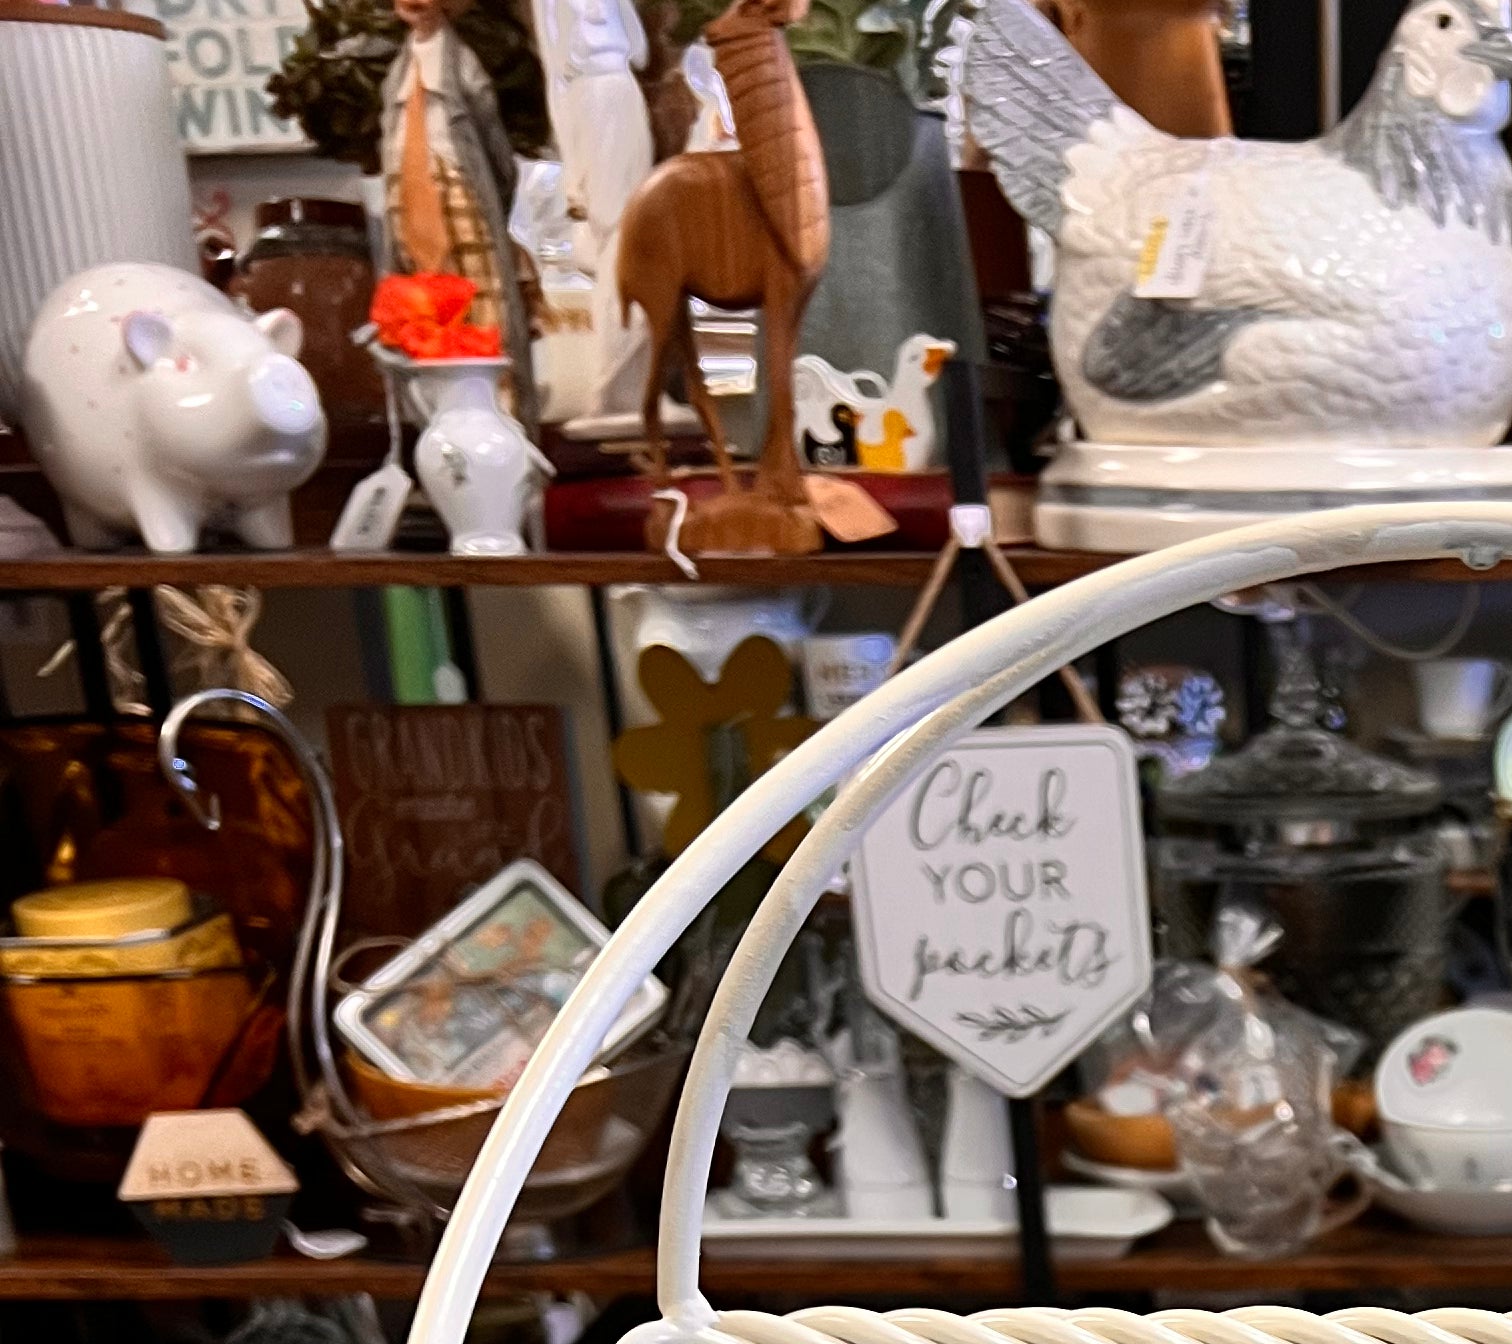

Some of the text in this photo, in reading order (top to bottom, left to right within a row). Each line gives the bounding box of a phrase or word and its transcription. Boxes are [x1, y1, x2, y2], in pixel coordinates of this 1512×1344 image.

[177, 86, 290, 139] WIN
[910, 758, 1079, 852] Check
[920, 860, 1072, 904] YOUR
[911, 906, 1125, 1002] pockets
[147, 1157, 262, 1188] HOME
[154, 1197, 265, 1222] MADE
